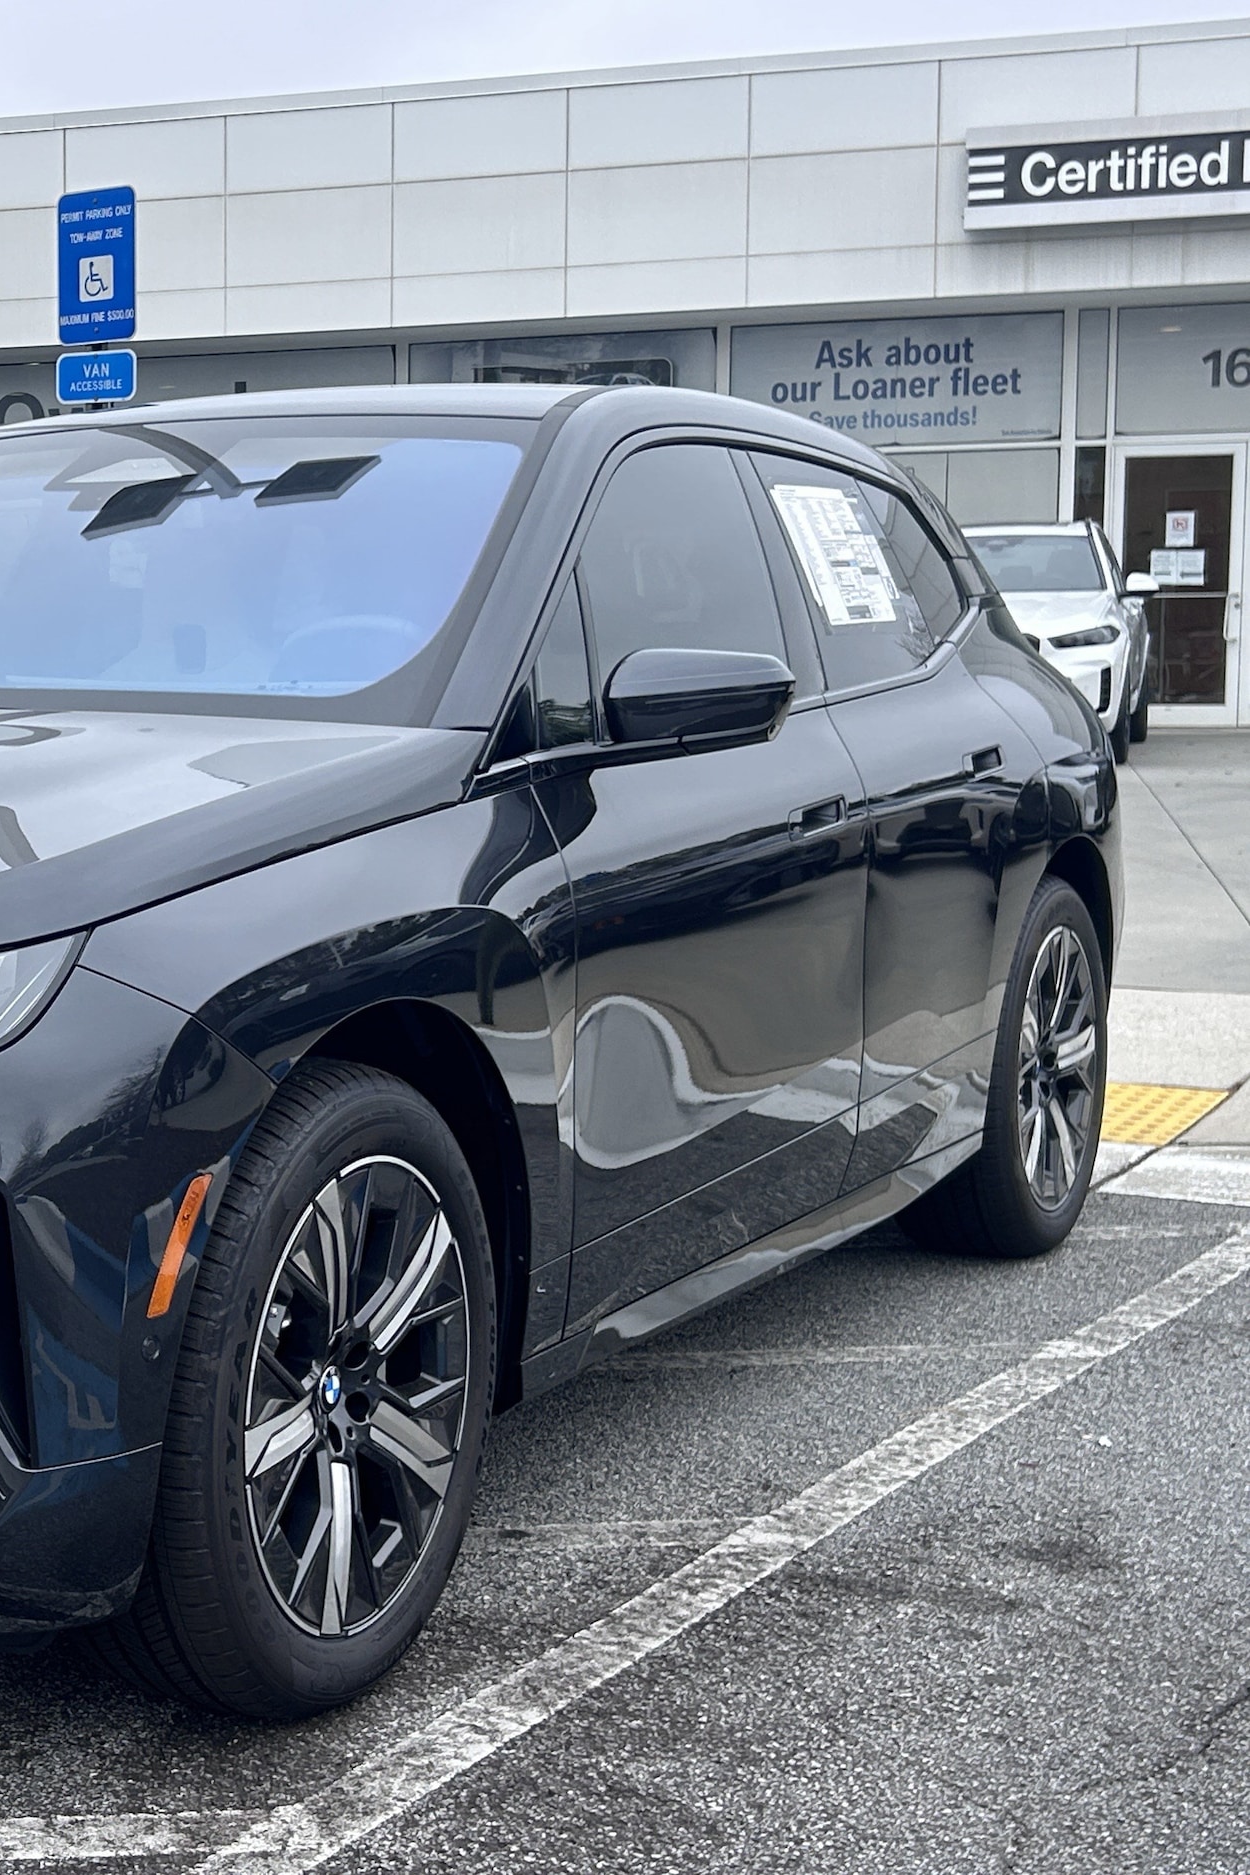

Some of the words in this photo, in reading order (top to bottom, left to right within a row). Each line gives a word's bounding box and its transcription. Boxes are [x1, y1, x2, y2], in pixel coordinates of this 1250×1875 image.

[1020, 140, 1230, 197] Certified
[60, 211, 84, 224] PERMIT
[85, 207, 114, 221] PARKING
[115, 204, 132, 217] ONLY
[70, 229, 104, 244] TOW-AWAY
[105, 227, 123, 240] ZONE
[59, 312, 90, 326] MAXIMUM
[91, 311, 105, 323] FINE
[815, 339, 873, 369] Ask
[884, 336, 974, 367] about
[82, 362, 110, 379] VAN
[69, 378, 123, 393] ACCESSIBLE
[771, 380, 822, 403] our
[833, 371, 940, 401] Loaner
[950, 367, 1022, 397] fleet
[862, 405, 978, 430] thousands!
